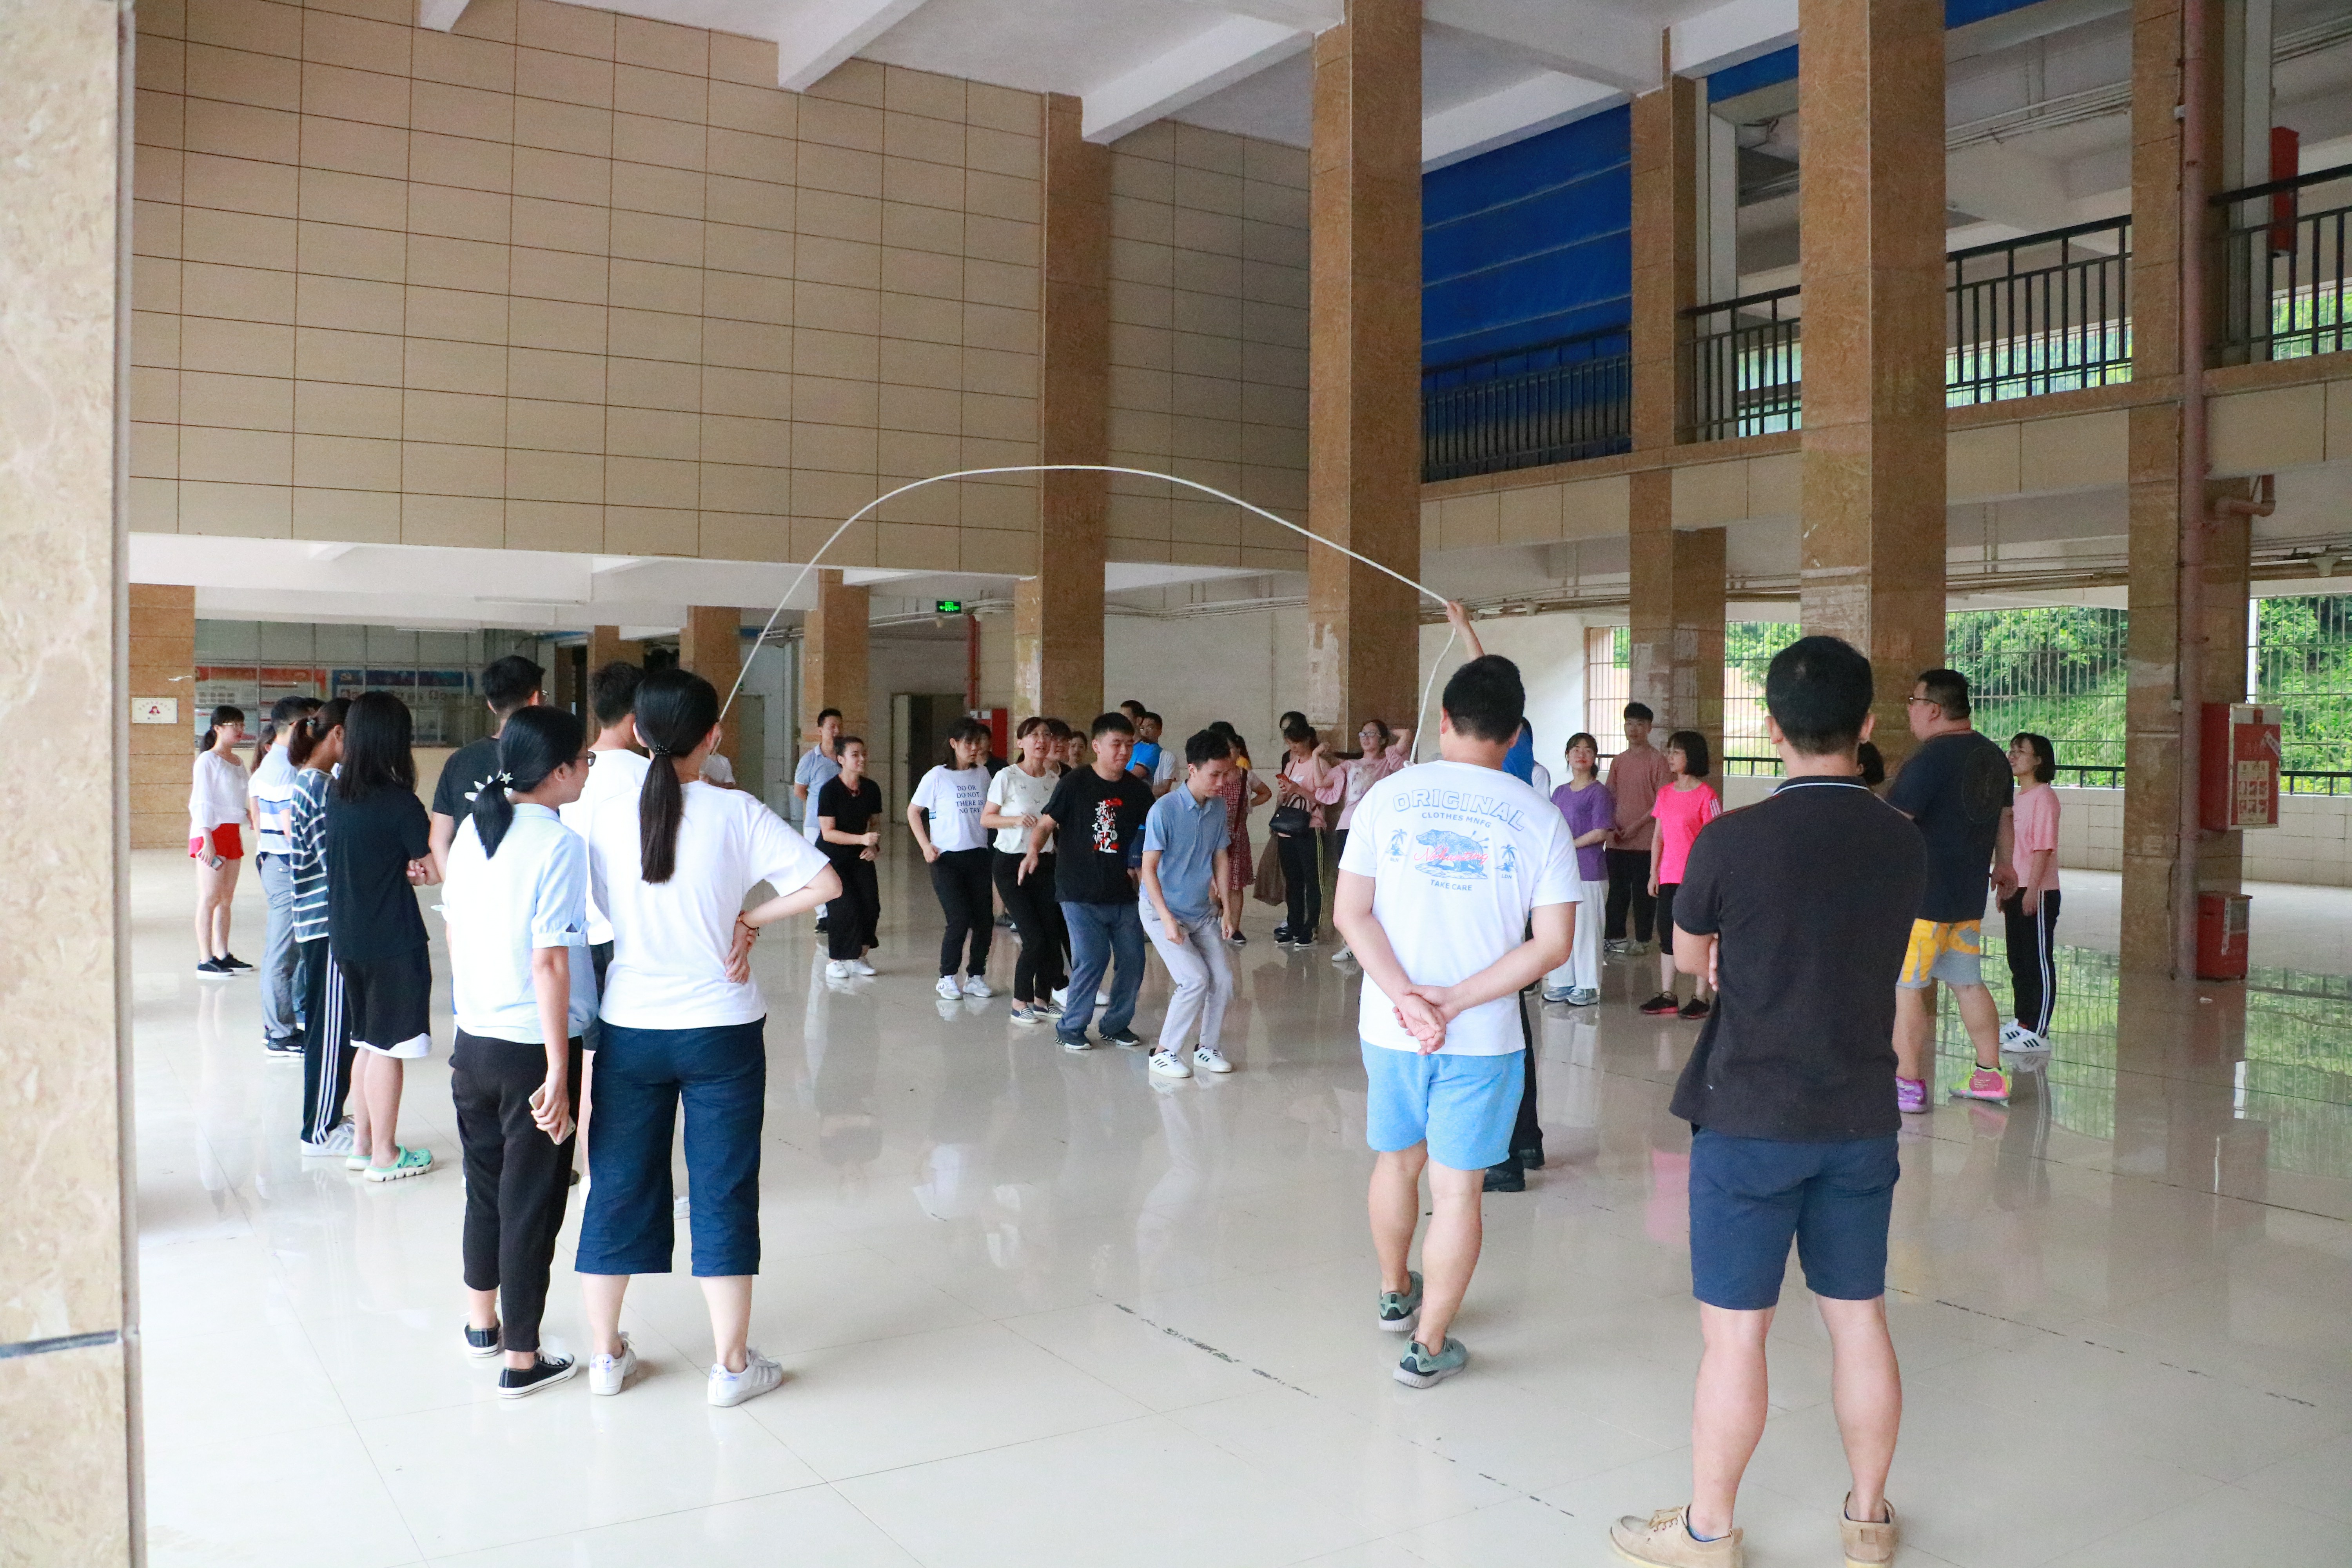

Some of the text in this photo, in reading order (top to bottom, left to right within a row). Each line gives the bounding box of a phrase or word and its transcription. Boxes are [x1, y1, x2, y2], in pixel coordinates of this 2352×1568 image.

[1393, 789, 1524, 831] ORIGINAL
[1422, 812, 1492, 828] CLOTHES MNFG
[1430, 879, 1450, 889] TAKE
